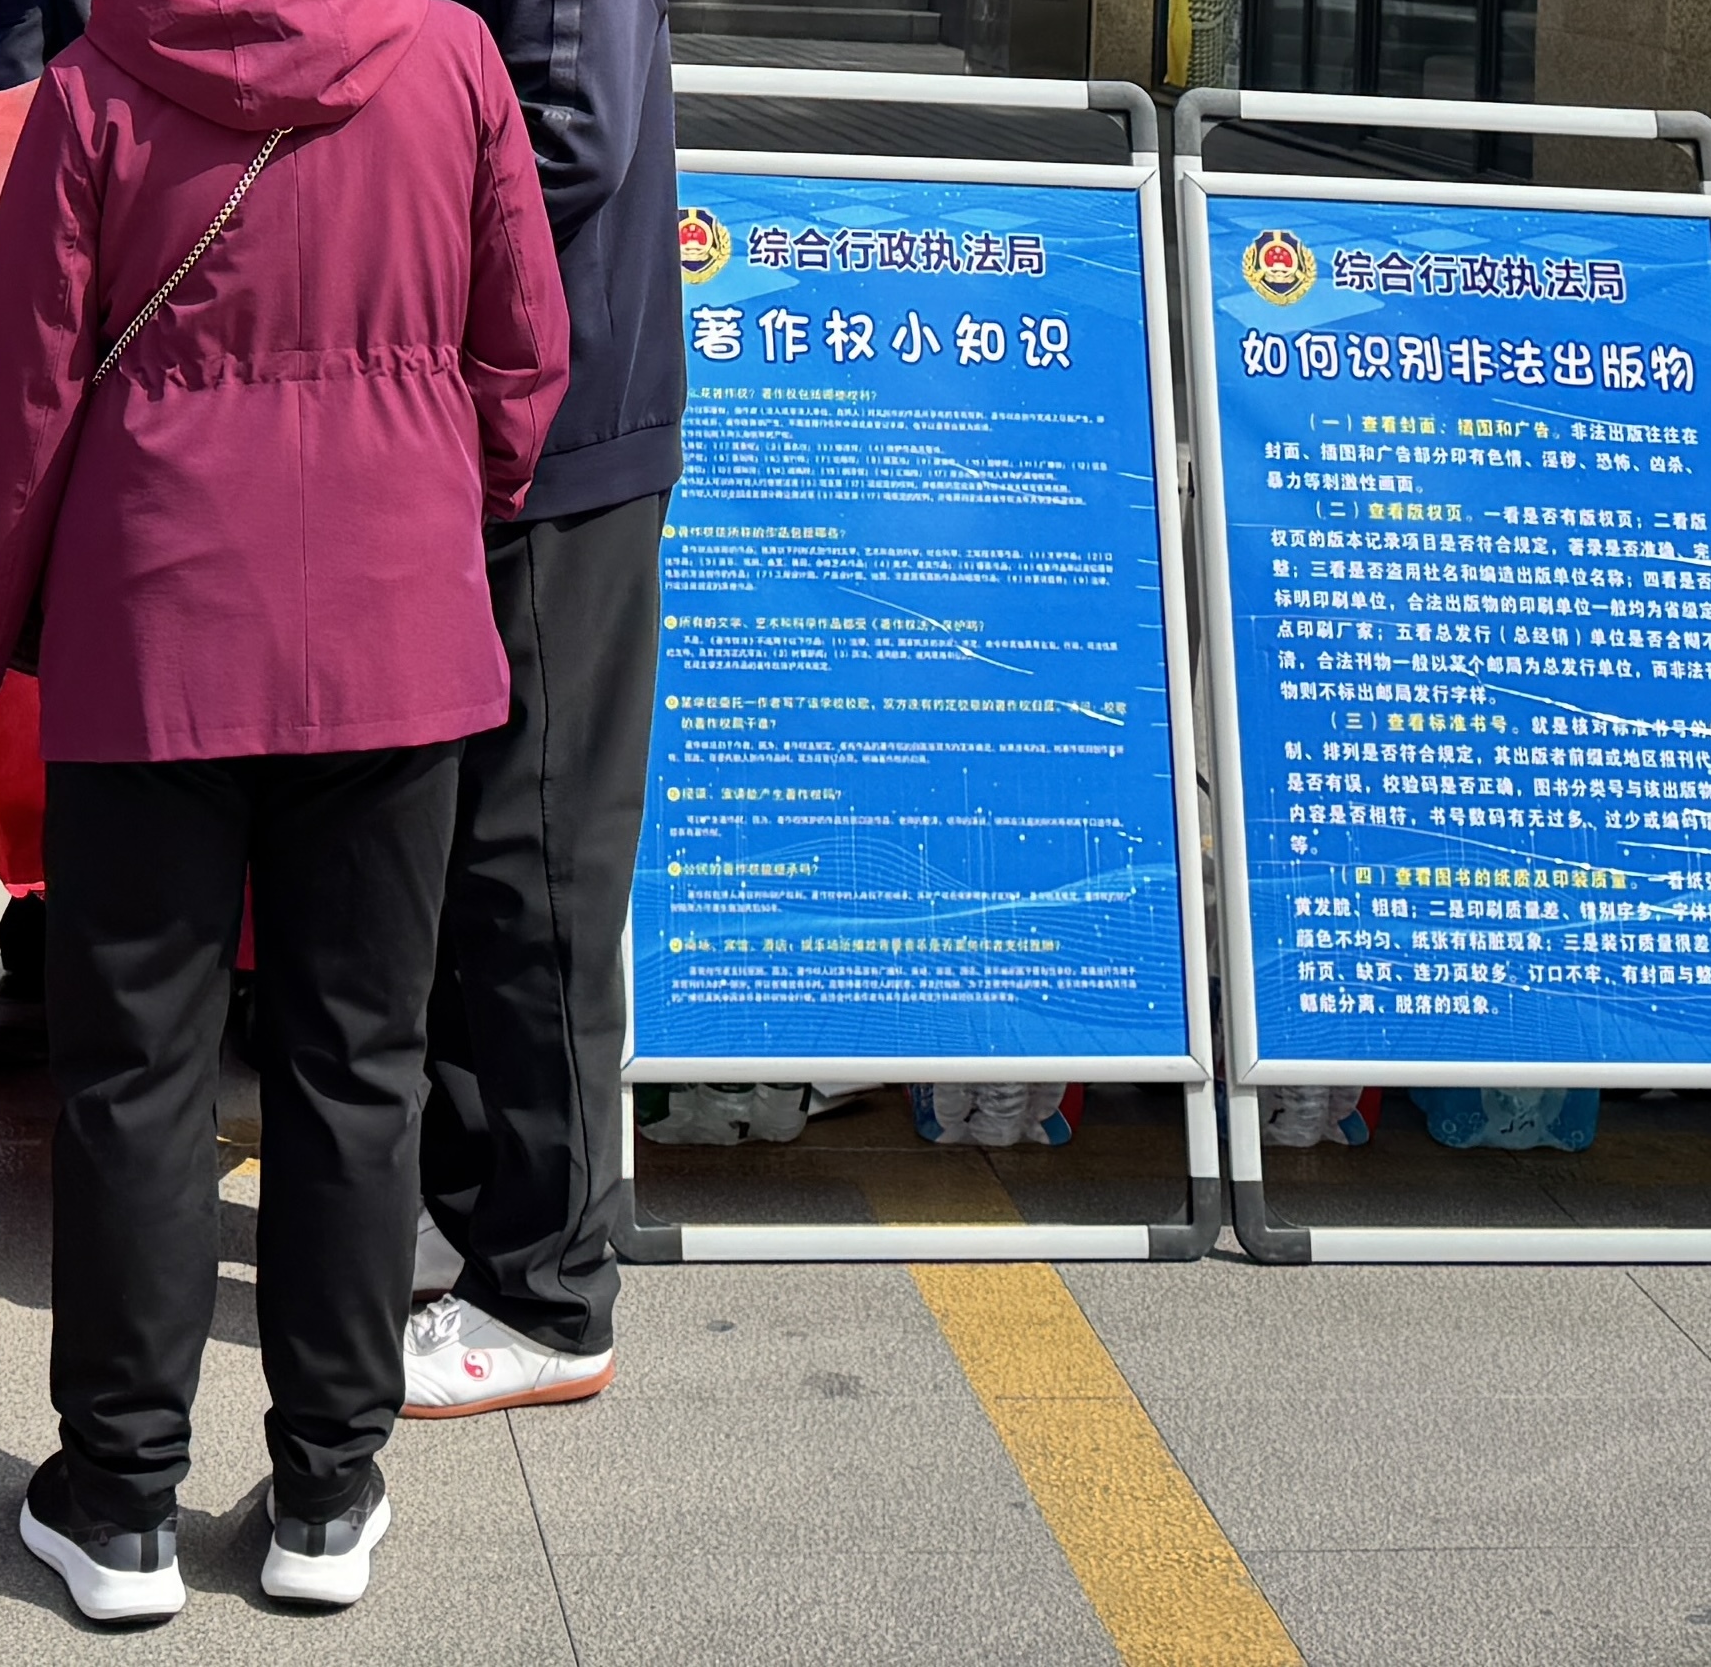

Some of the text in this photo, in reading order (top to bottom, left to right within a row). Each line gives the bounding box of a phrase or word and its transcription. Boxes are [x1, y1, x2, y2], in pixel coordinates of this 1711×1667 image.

[746, 226, 1046, 277] 综合行政执法局
[1332, 249, 1627, 304] 综合行政执法局
[691, 304, 1072, 369] 著作权小知识
[1242, 330, 1696, 393] 如何识别非法出版物
